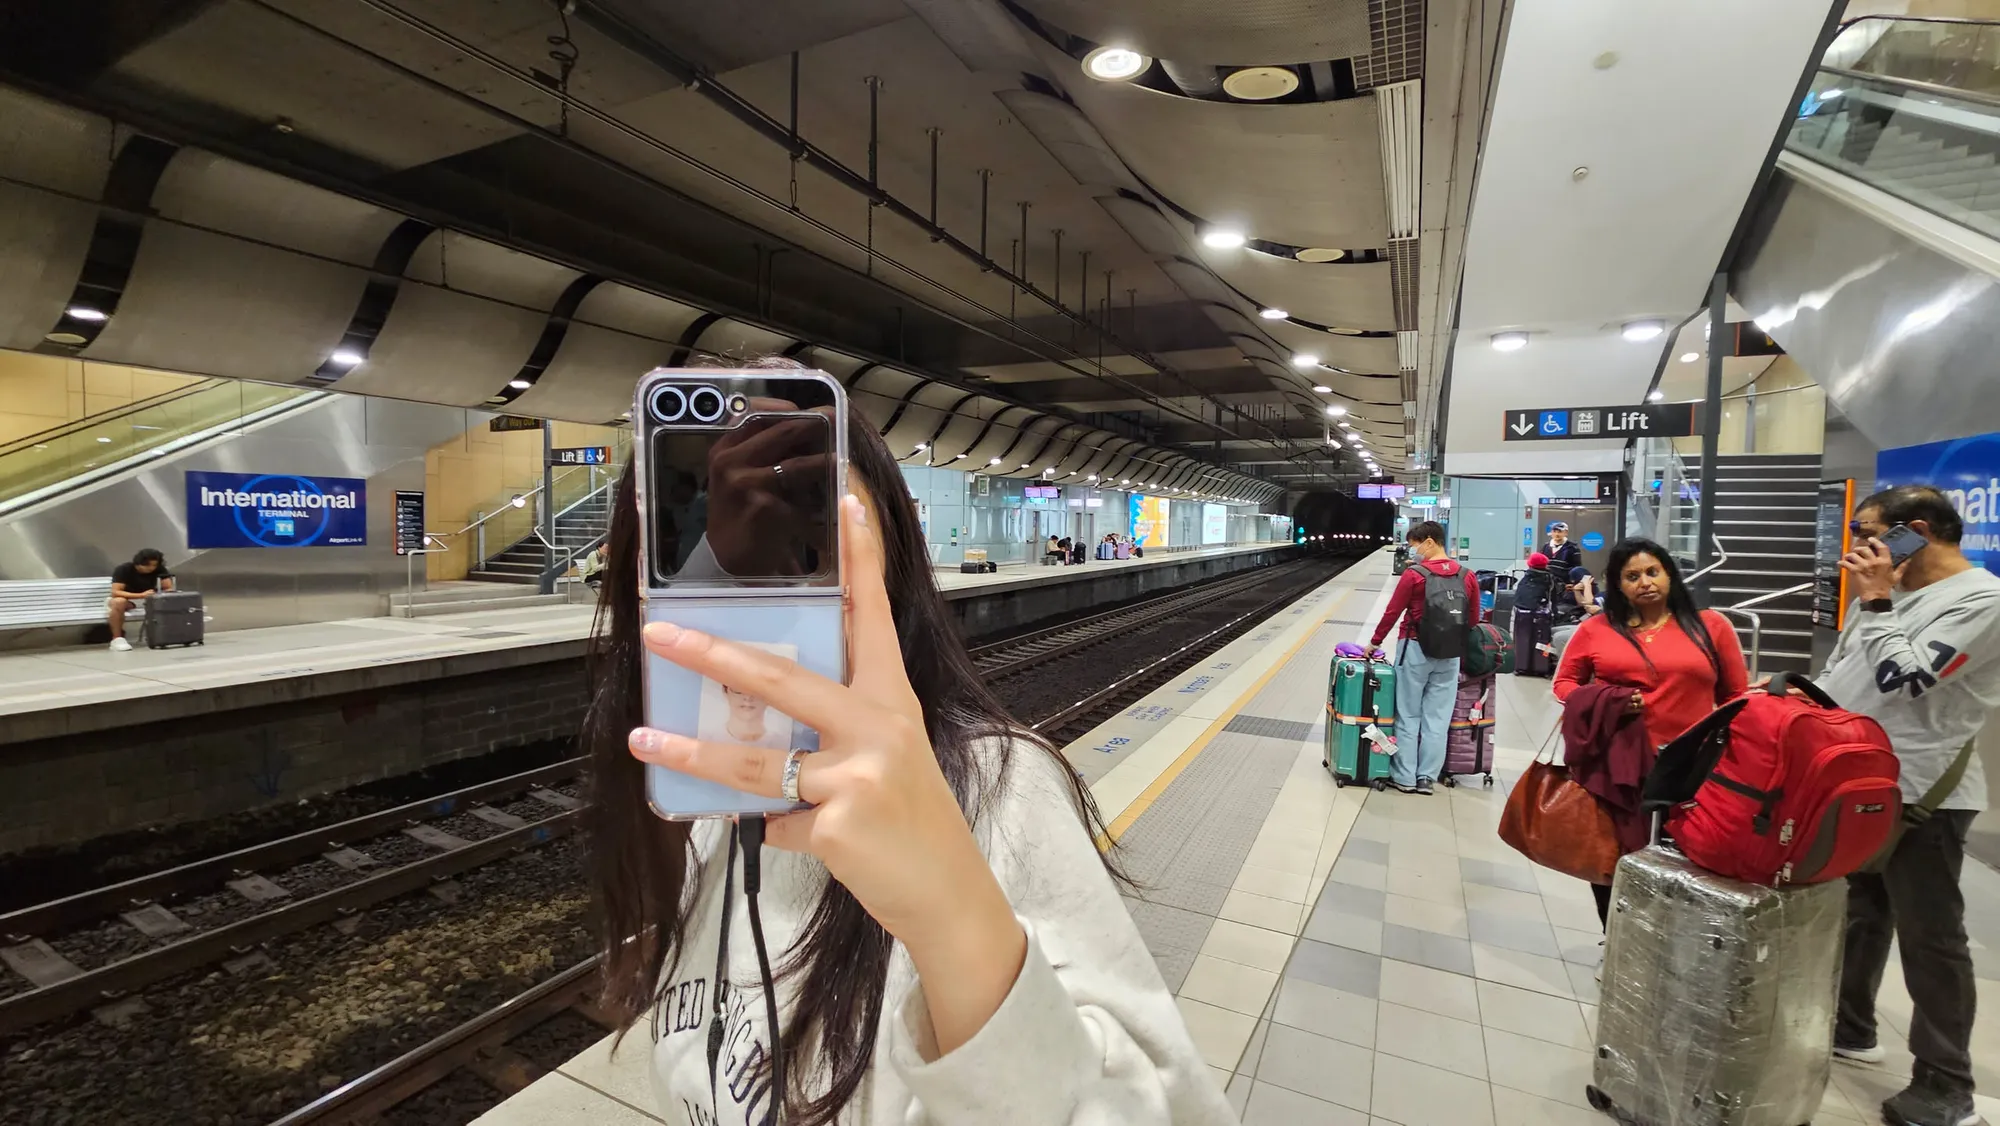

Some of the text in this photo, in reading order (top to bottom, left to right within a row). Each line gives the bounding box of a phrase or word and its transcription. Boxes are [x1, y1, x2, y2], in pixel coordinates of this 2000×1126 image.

[1607, 412, 1649, 431] Lift
[561, 451, 575, 462] Lift
[201, 486, 356, 509] International
[1603, 486, 1611, 495] 1
[257, 509, 310, 518] TERMINAL
[1092, 737, 1131, 754] Area
